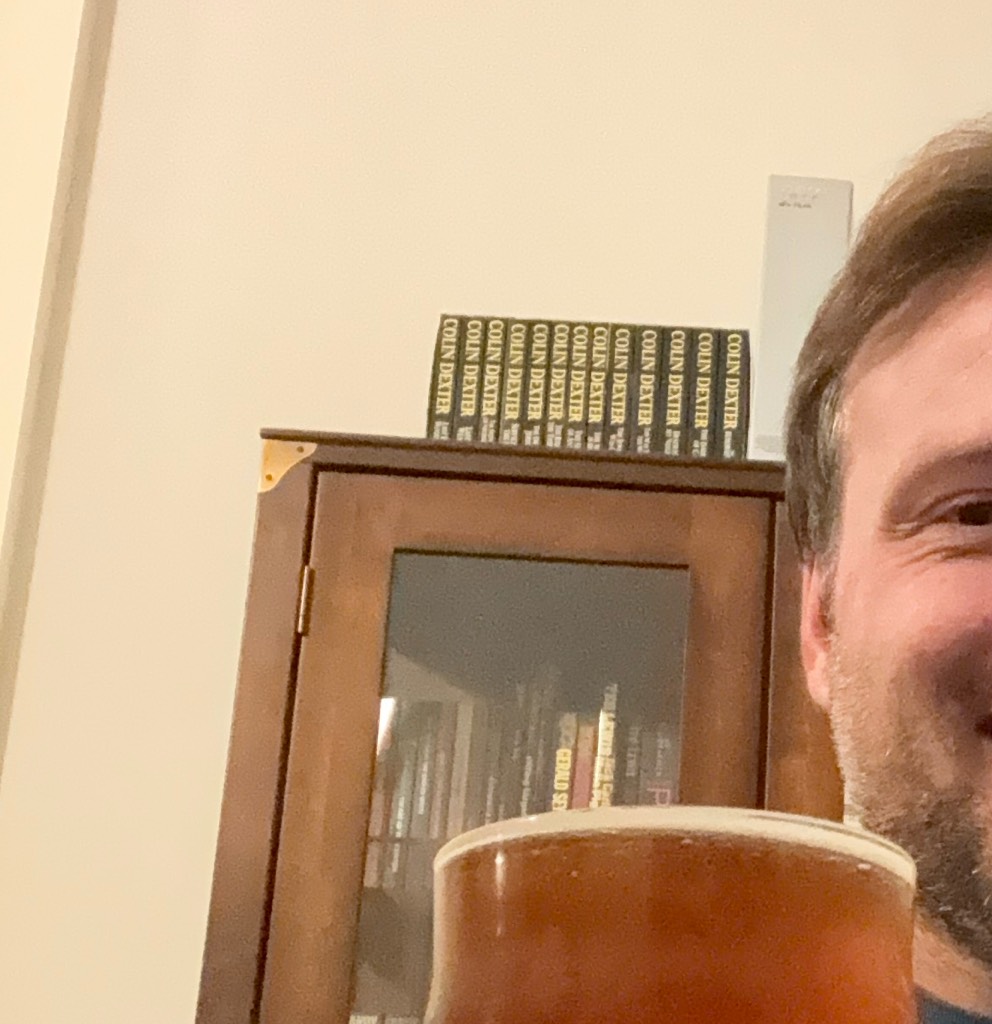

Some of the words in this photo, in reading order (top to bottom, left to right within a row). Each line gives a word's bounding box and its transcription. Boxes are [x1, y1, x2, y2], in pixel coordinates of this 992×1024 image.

[441, 318, 458, 360] COLIN
[466, 320, 482, 361] COLIN
[487, 320, 504, 361] COLIN
[510, 324, 526, 364] COLIN
[532, 324, 548, 364] COLIN
[552, 324, 569, 365] COLIN
[572, 326, 588, 367] COLIN
[592, 327, 608, 368] COLIN
[614, 328, 630, 369] COLIN
[642, 330, 657, 371] COLIN
[669, 330, 685, 371] COLIN
[697, 333, 713, 373] COLIN
[726, 334, 742, 375] COLIN
[435, 362, 455, 414] DEXTER
[460, 364, 479, 416] DEXTER
[481, 364, 500, 416] DEXTER
[504, 368, 523, 420] DEXTER
[528, 368, 546, 420] DEXTER
[548, 368, 566, 420] DEXTER
[568, 370, 586, 422] DEXTER
[588, 371, 606, 423] DEXTER
[610, 373, 628, 425] DEXTER
[638, 374, 655, 426] DEXTER
[666, 374, 683, 426] DEXTER
[694, 377, 711, 429] DEXTER
[723, 378, 740, 430] DEXTER
